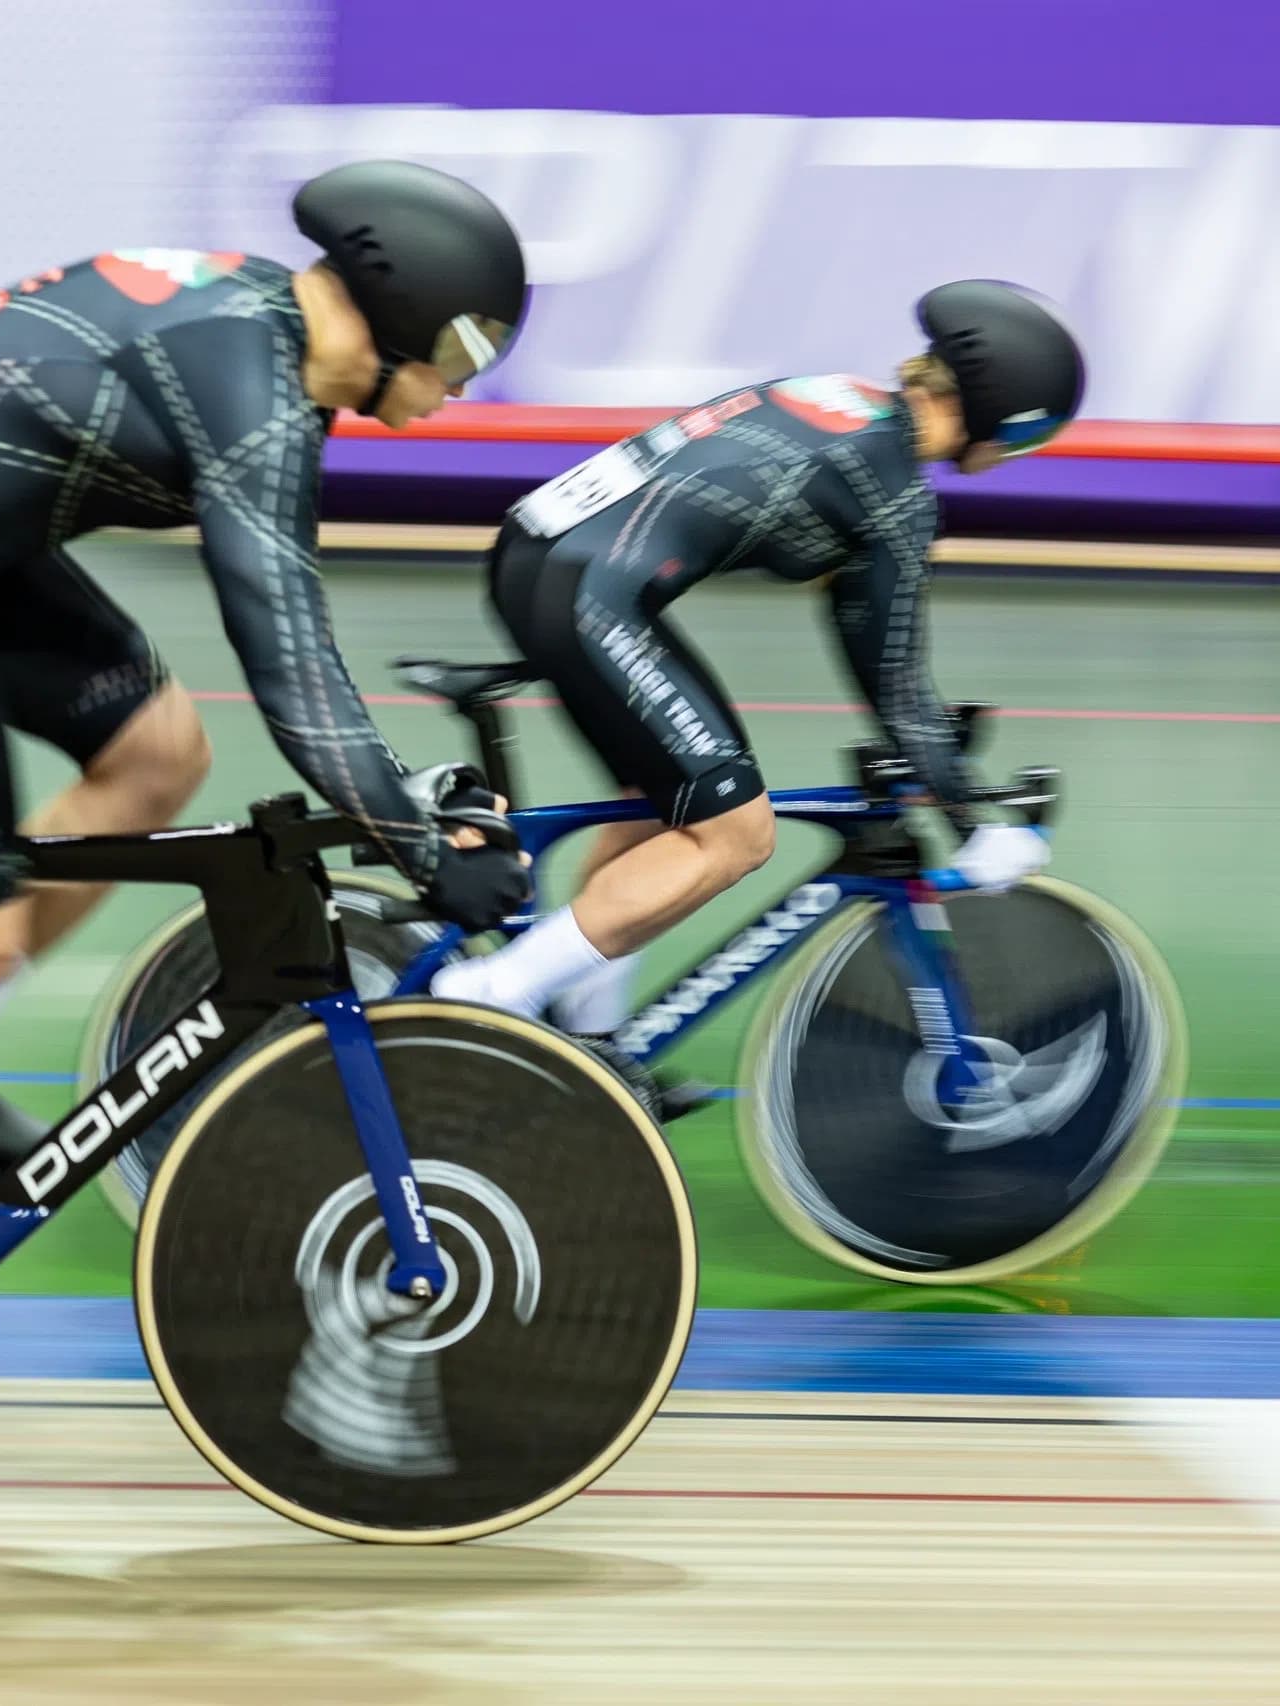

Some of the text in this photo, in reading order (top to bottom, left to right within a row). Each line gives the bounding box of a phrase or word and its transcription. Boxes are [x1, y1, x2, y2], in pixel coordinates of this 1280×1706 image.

[663, 695, 718, 757] TEAM
[16, 999, 225, 1203] DOLAN
[399, 1175, 431, 1244] DOLAN
